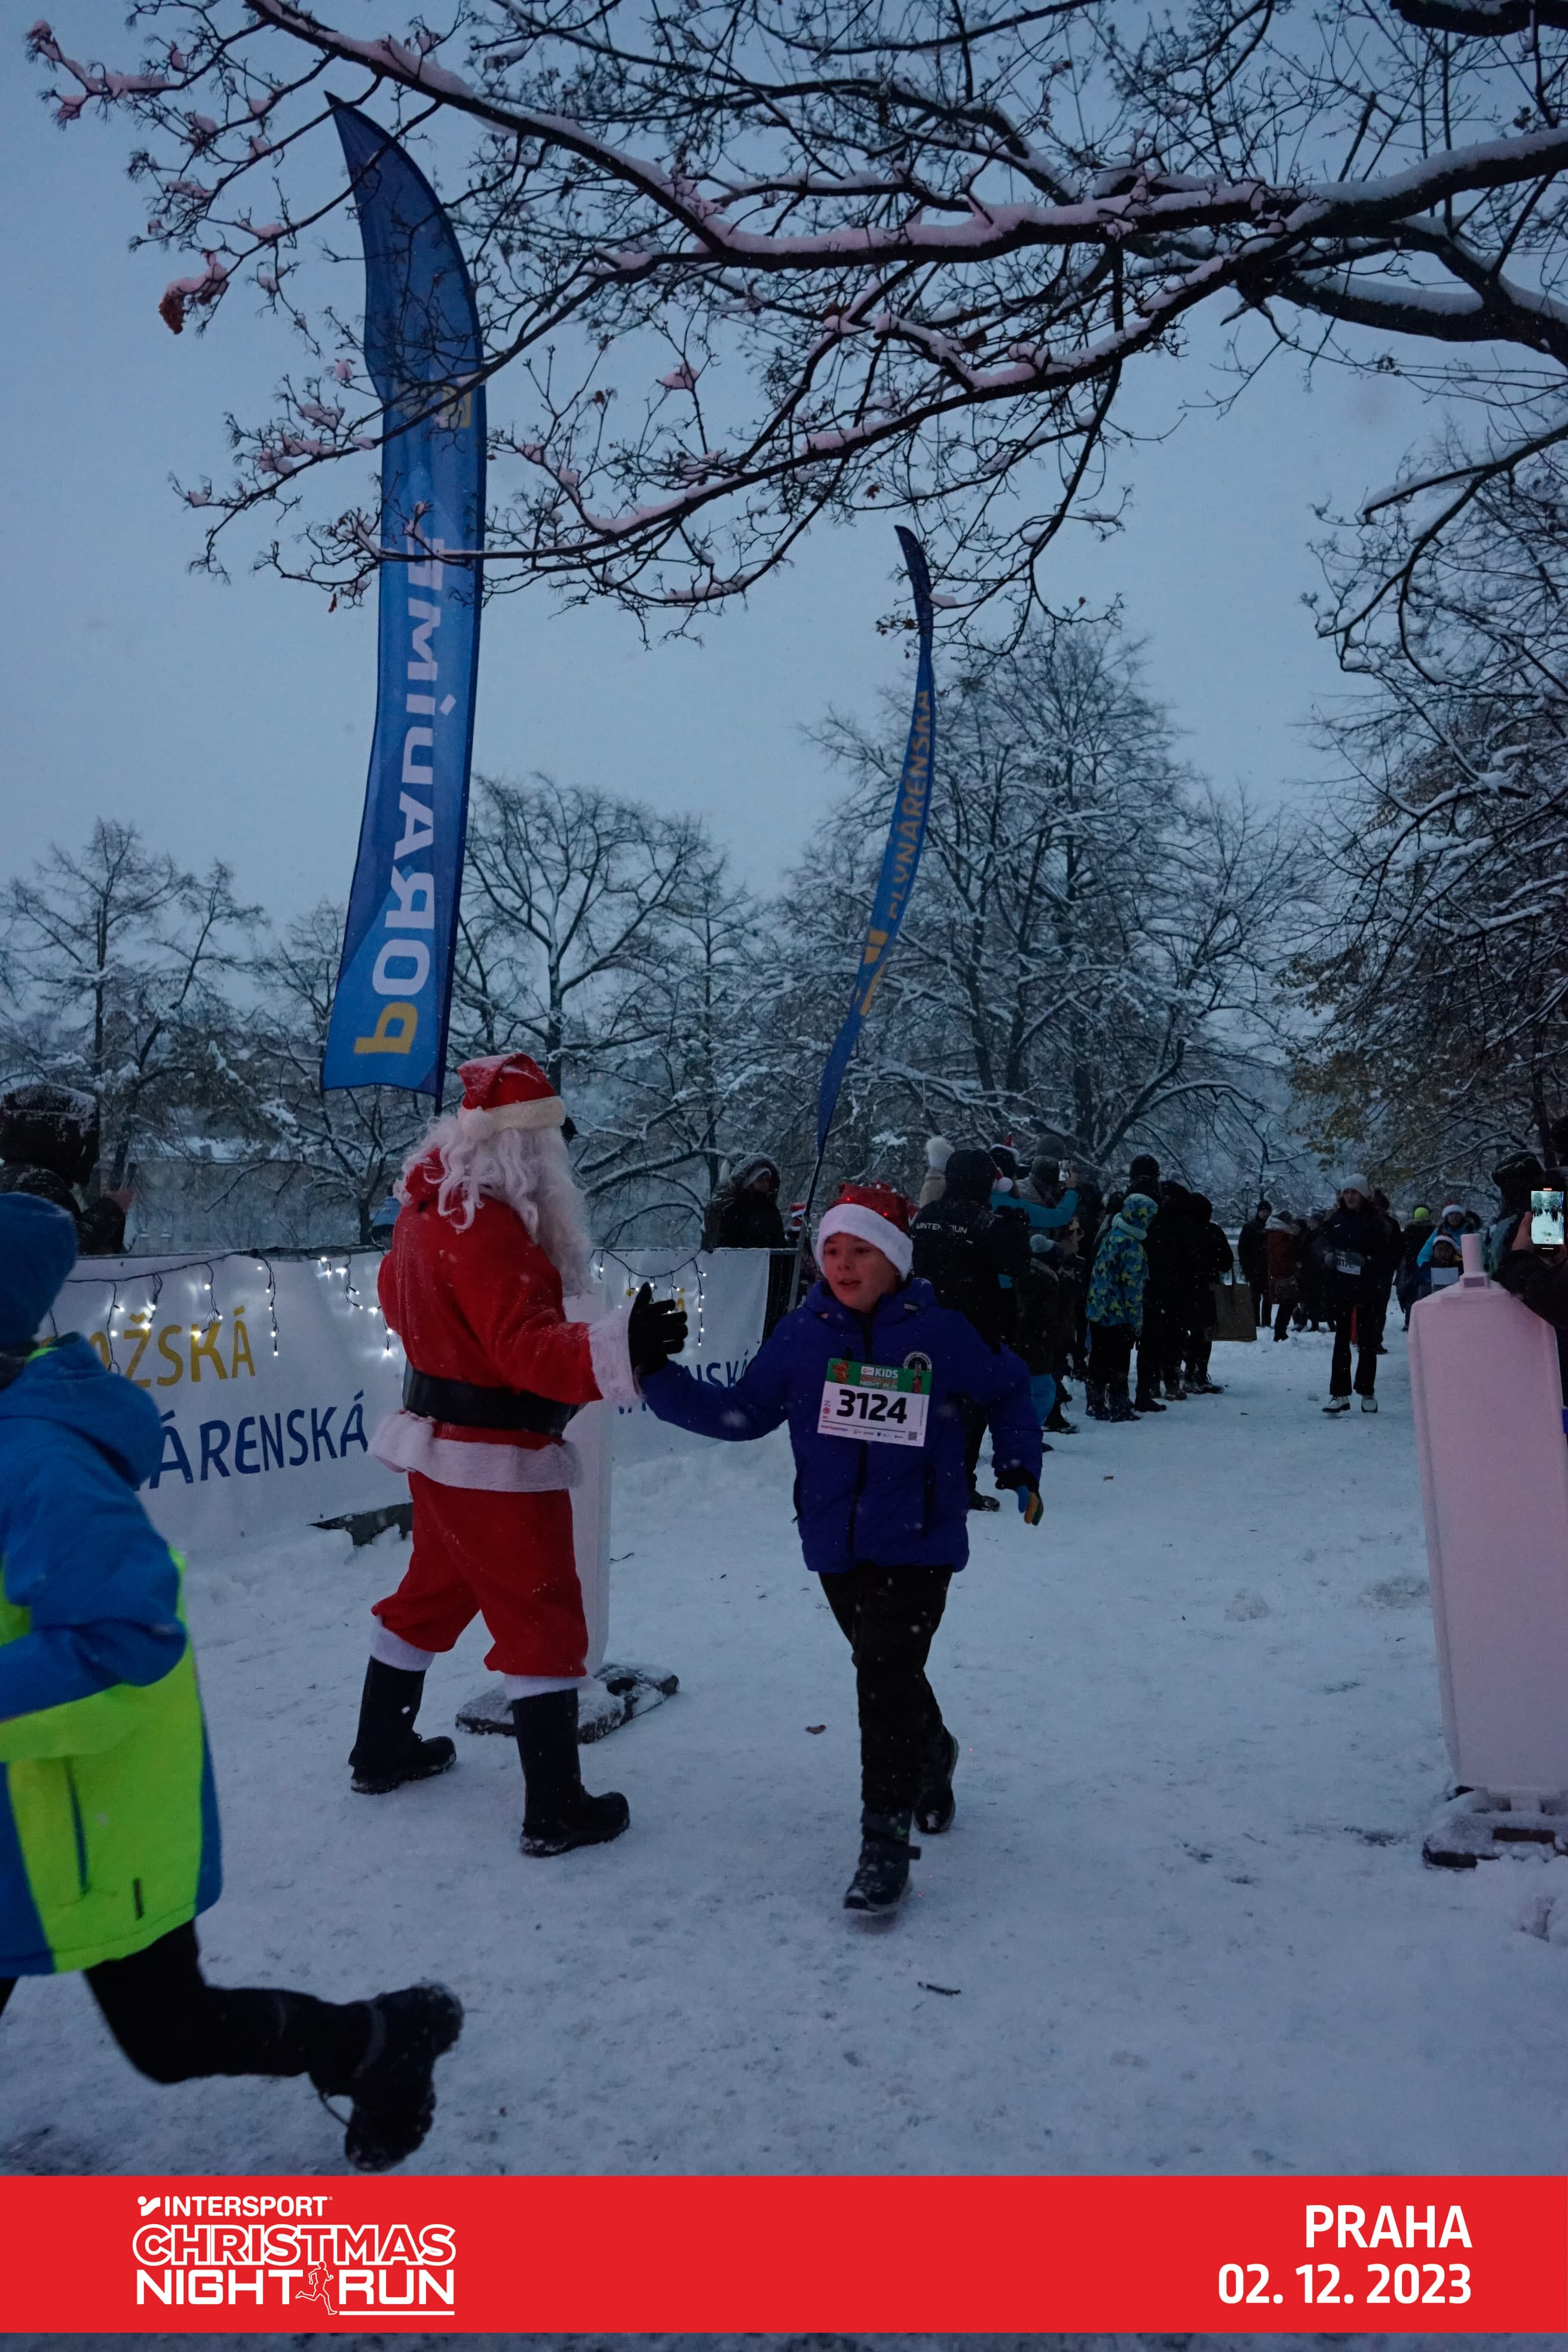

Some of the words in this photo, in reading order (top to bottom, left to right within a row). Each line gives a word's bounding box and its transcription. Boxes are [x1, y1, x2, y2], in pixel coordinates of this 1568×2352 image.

[39, 1306, 256, 1388] ŽSKÁ
[874, 1367, 899, 1379] KIDS
[837, 1389, 907, 1424] 3124
[134, 1390, 369, 1491] ÁRENSKÁ
